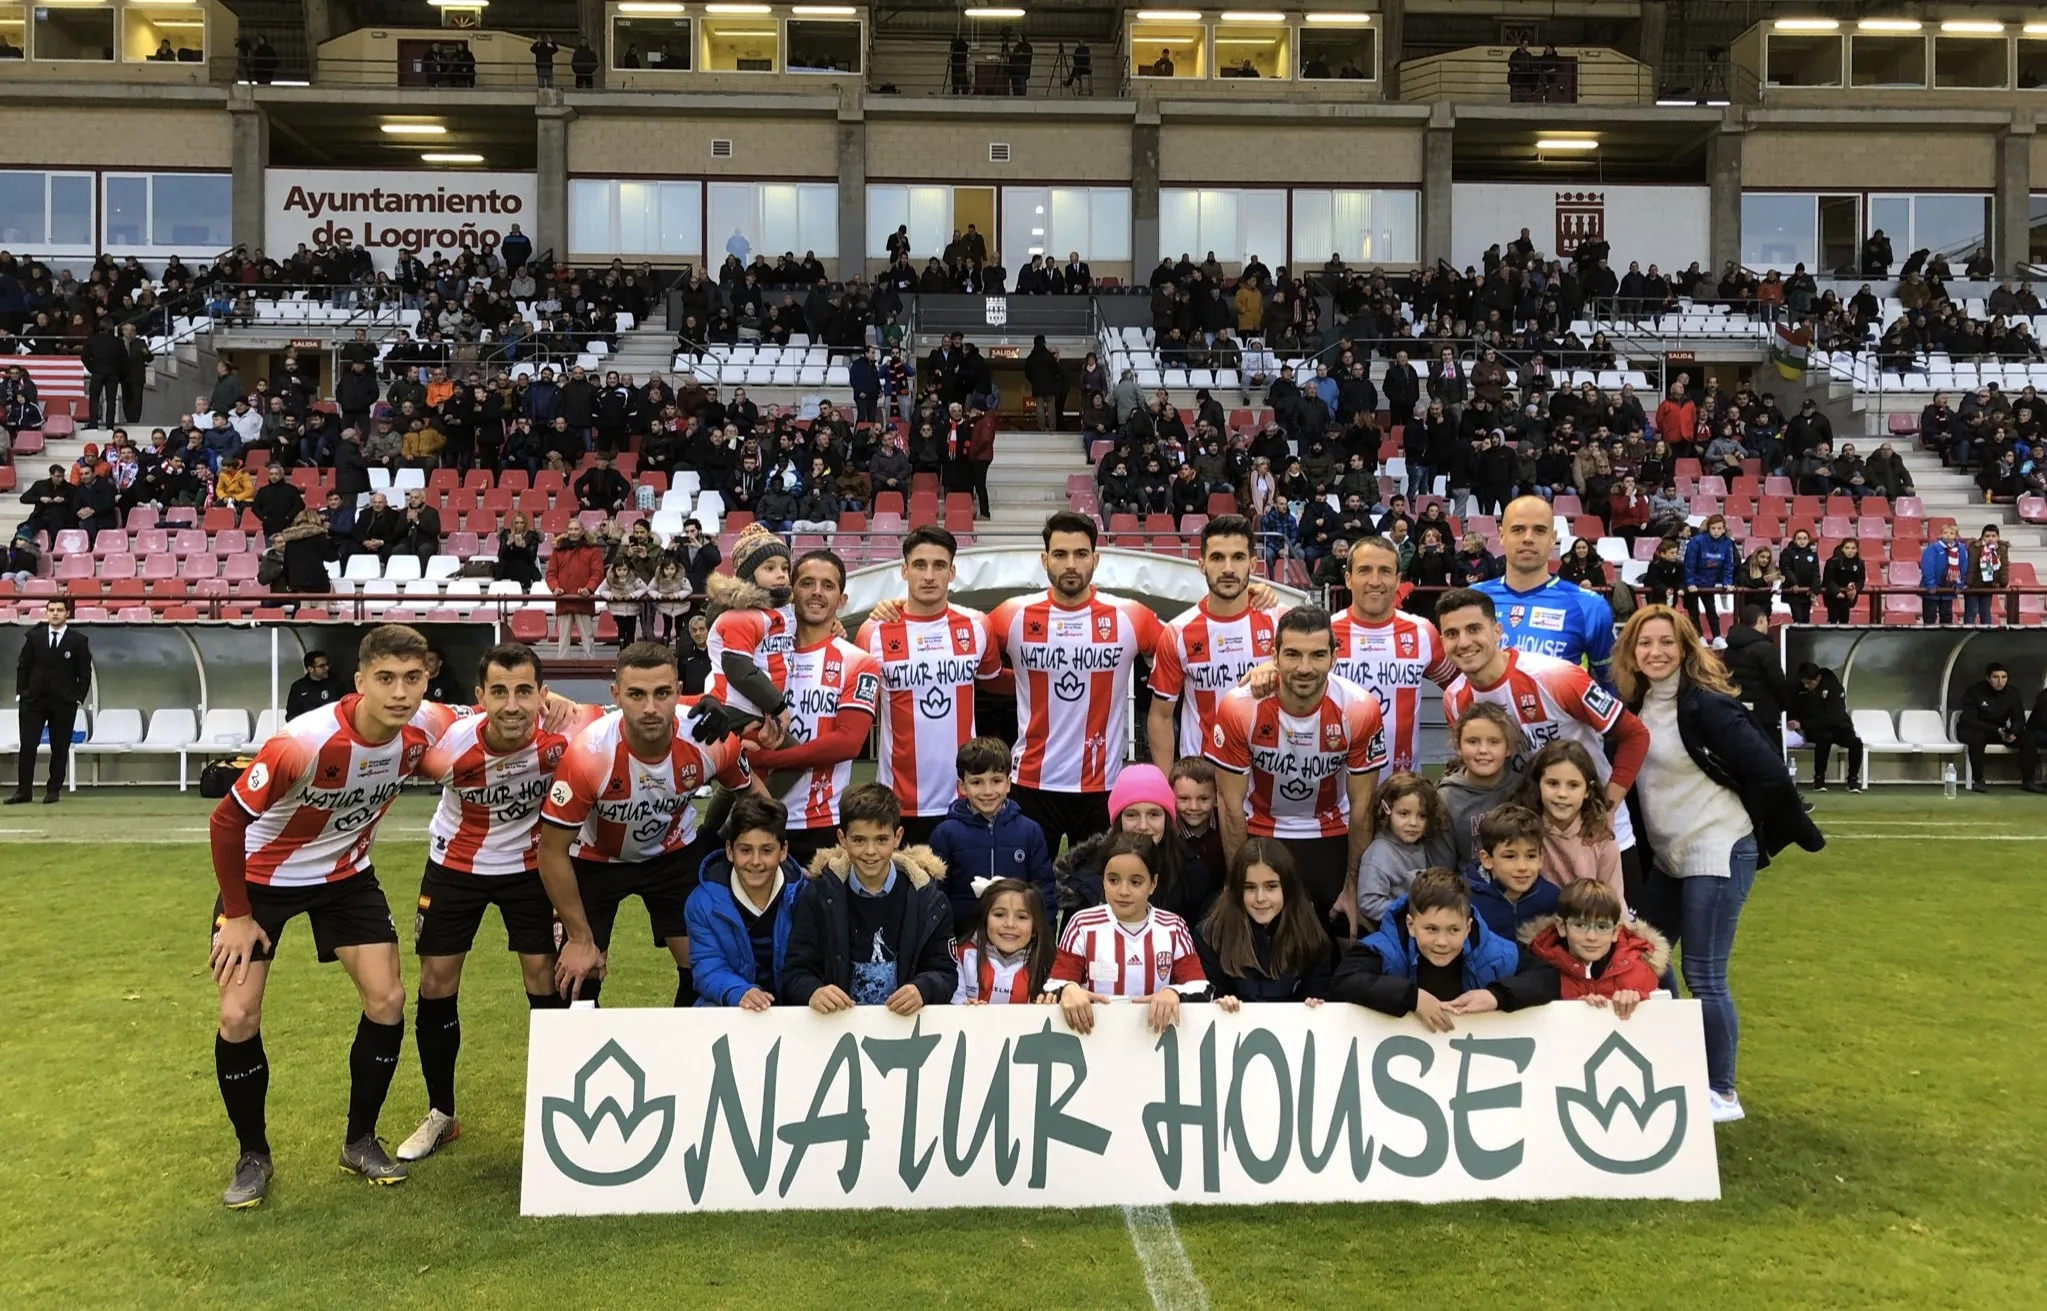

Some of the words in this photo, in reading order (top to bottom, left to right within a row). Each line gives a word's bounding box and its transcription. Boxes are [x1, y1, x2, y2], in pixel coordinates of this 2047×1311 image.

[283, 185, 523, 219] Ayuntamiento
[312, 220, 353, 247] de
[364, 222, 501, 254] Logroño
[992, 349, 1017, 357] SALIDA
[1020, 645, 1068, 670] NATUR
[1072, 646, 1123, 671] HOUSE
[882, 661, 932, 689] NATUR
[1377, 661, 1425, 686] HOUSE
[296, 786, 365, 809] NATUR
[593, 799, 653, 821] NATUR
[225, 1063, 264, 1080] KELME
[684, 1014, 1113, 1206] NATUR
[1142, 1020, 1536, 1193] HOUSE
